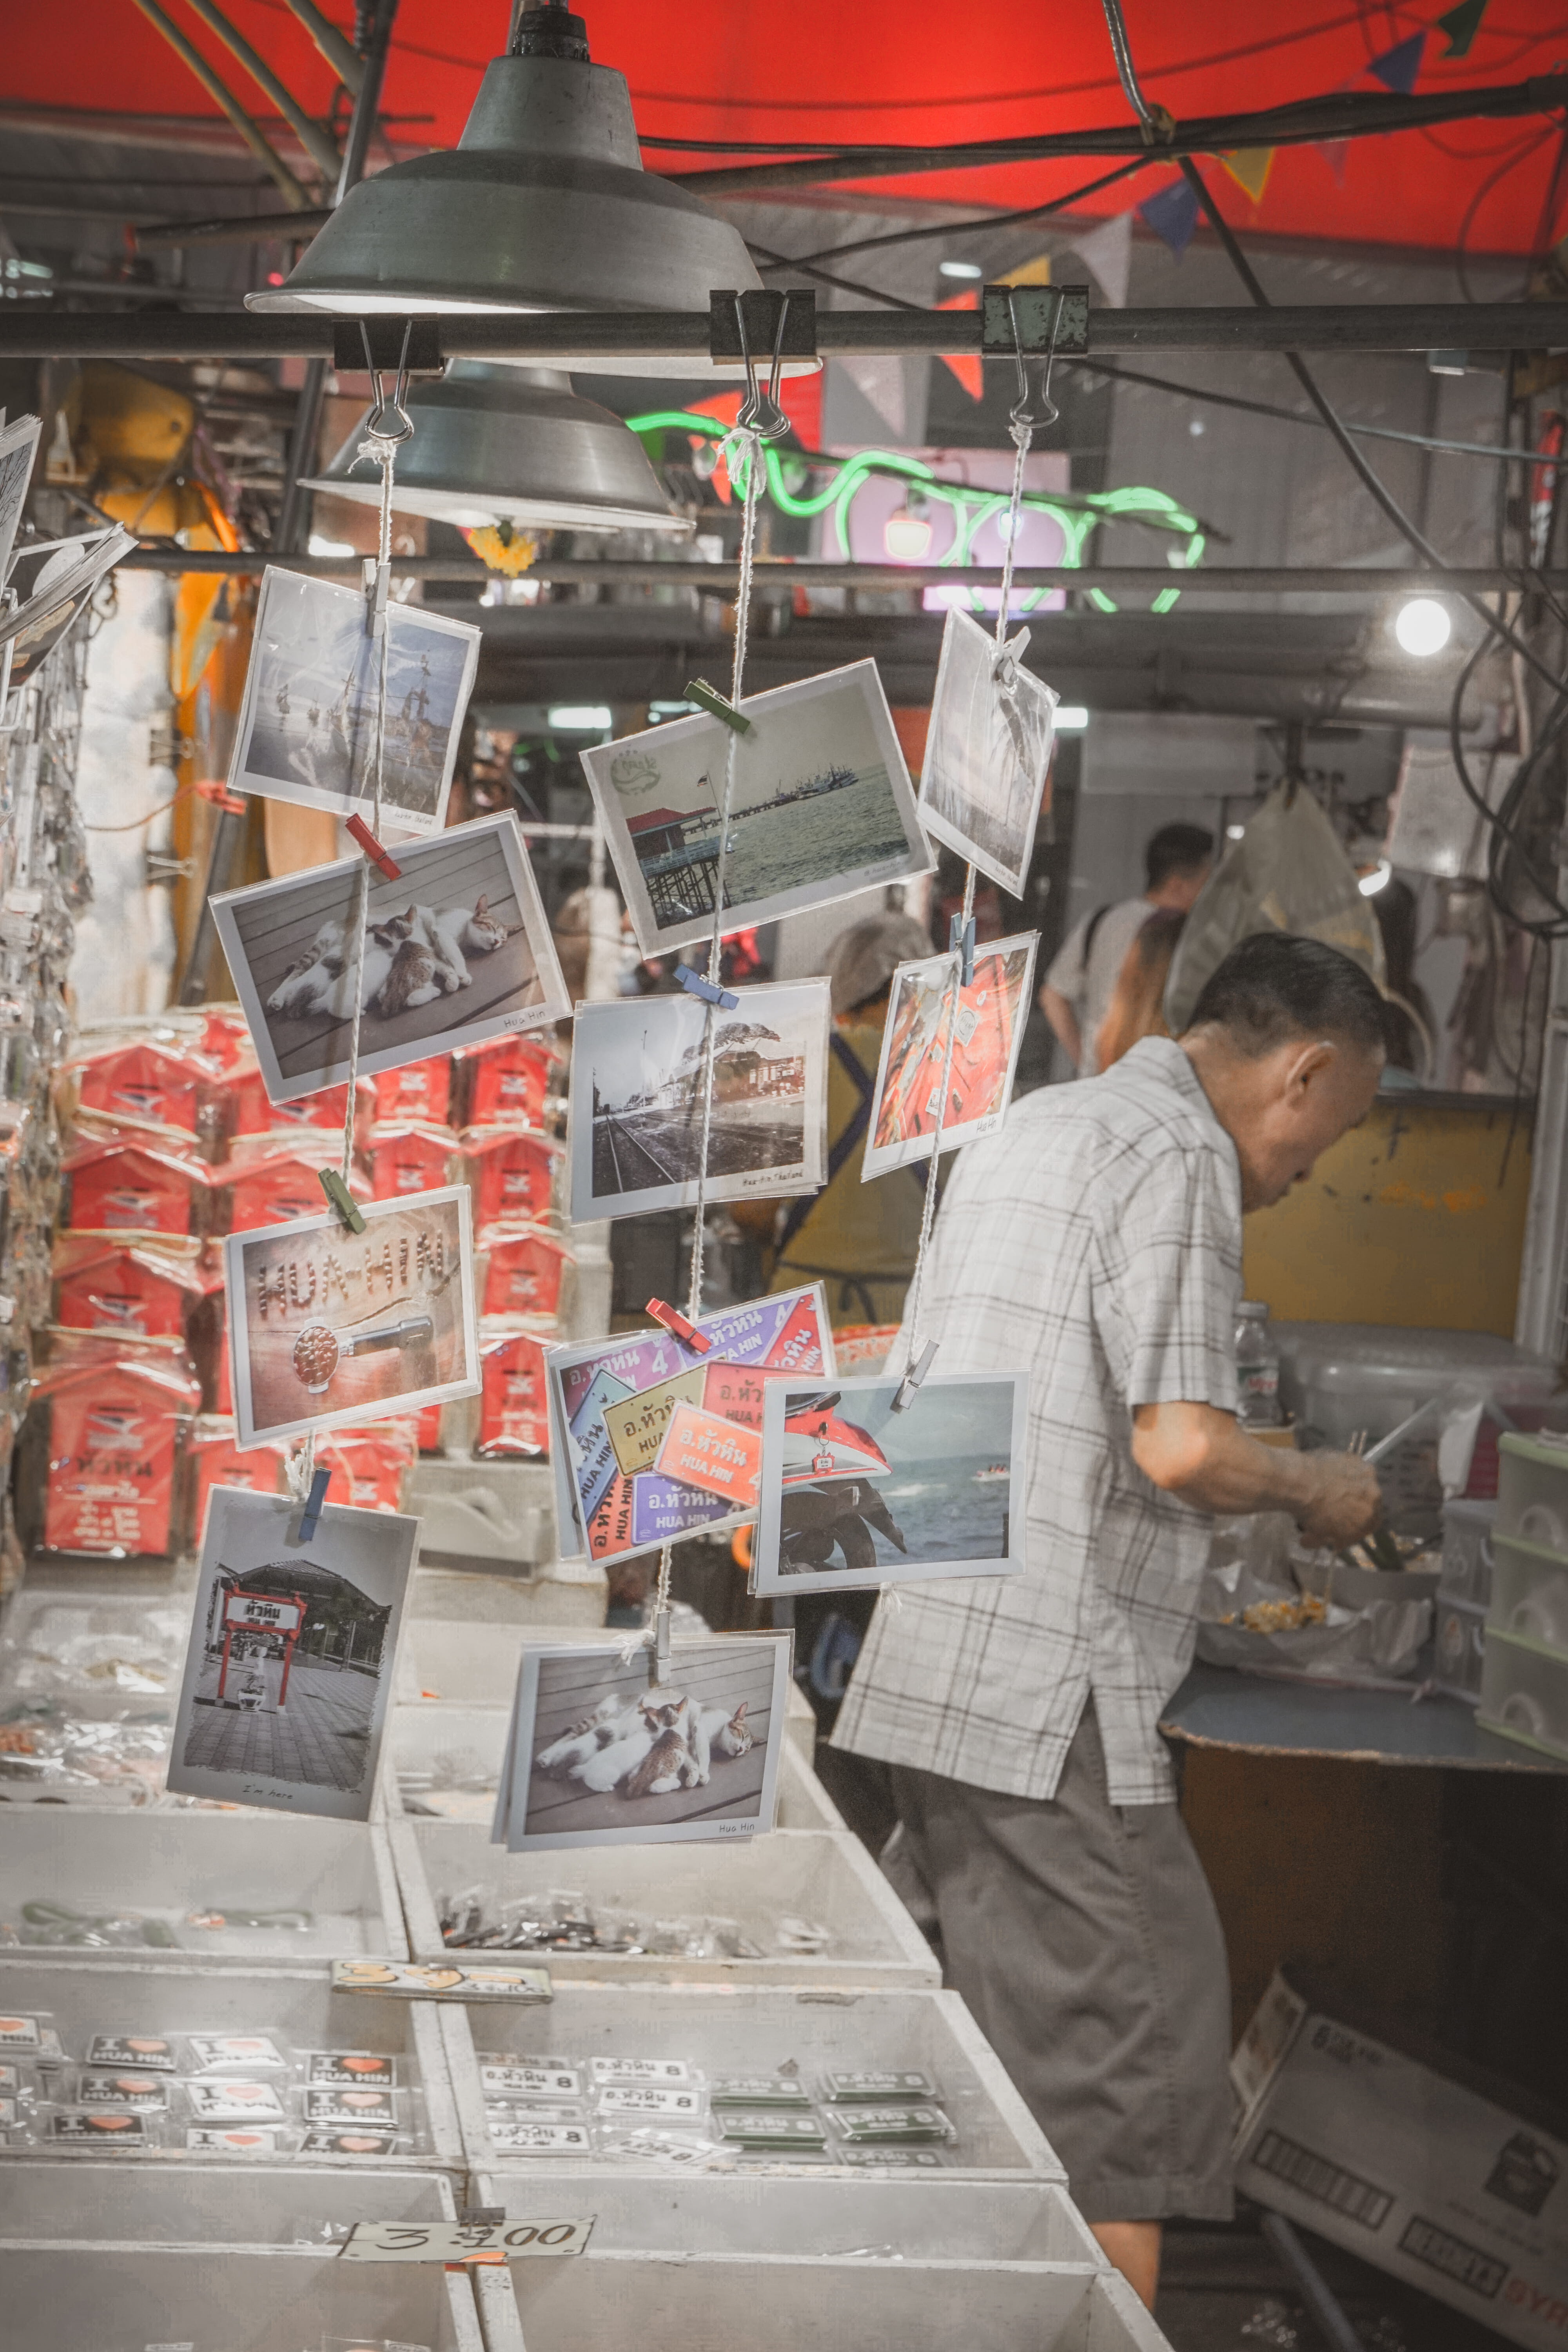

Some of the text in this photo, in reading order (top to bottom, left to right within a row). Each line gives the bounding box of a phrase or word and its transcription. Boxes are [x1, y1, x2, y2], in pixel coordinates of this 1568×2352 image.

[504, 1011, 545, 1027] Hua Hin
[976, 1117, 997, 1134] Hua Hin
[738, 1334, 762, 1354] HIN
[652, 1349, 668, 1375] 4
[725, 1409, 753, 1423] HUA
[680, 1429, 747, 1466] อ.หัวหิน
[680, 1454, 708, 1474] HUA
[709, 1465, 734, 1483] HIN
[580, 1469, 601, 1499] HUA
[615, 1479, 633, 1540] HUA HIN
[656, 1516, 684, 1528] HUA
[719, 1822, 754, 1833] Hua Hin
[98, 2038, 122, 2051] I
[316, 2057, 339, 2071] I
[88, 2078, 110, 2091] I
[313, 2092, 336, 2107] I
[60, 2117, 85, 2131] I
[375, 2228, 430, 2250] 3
